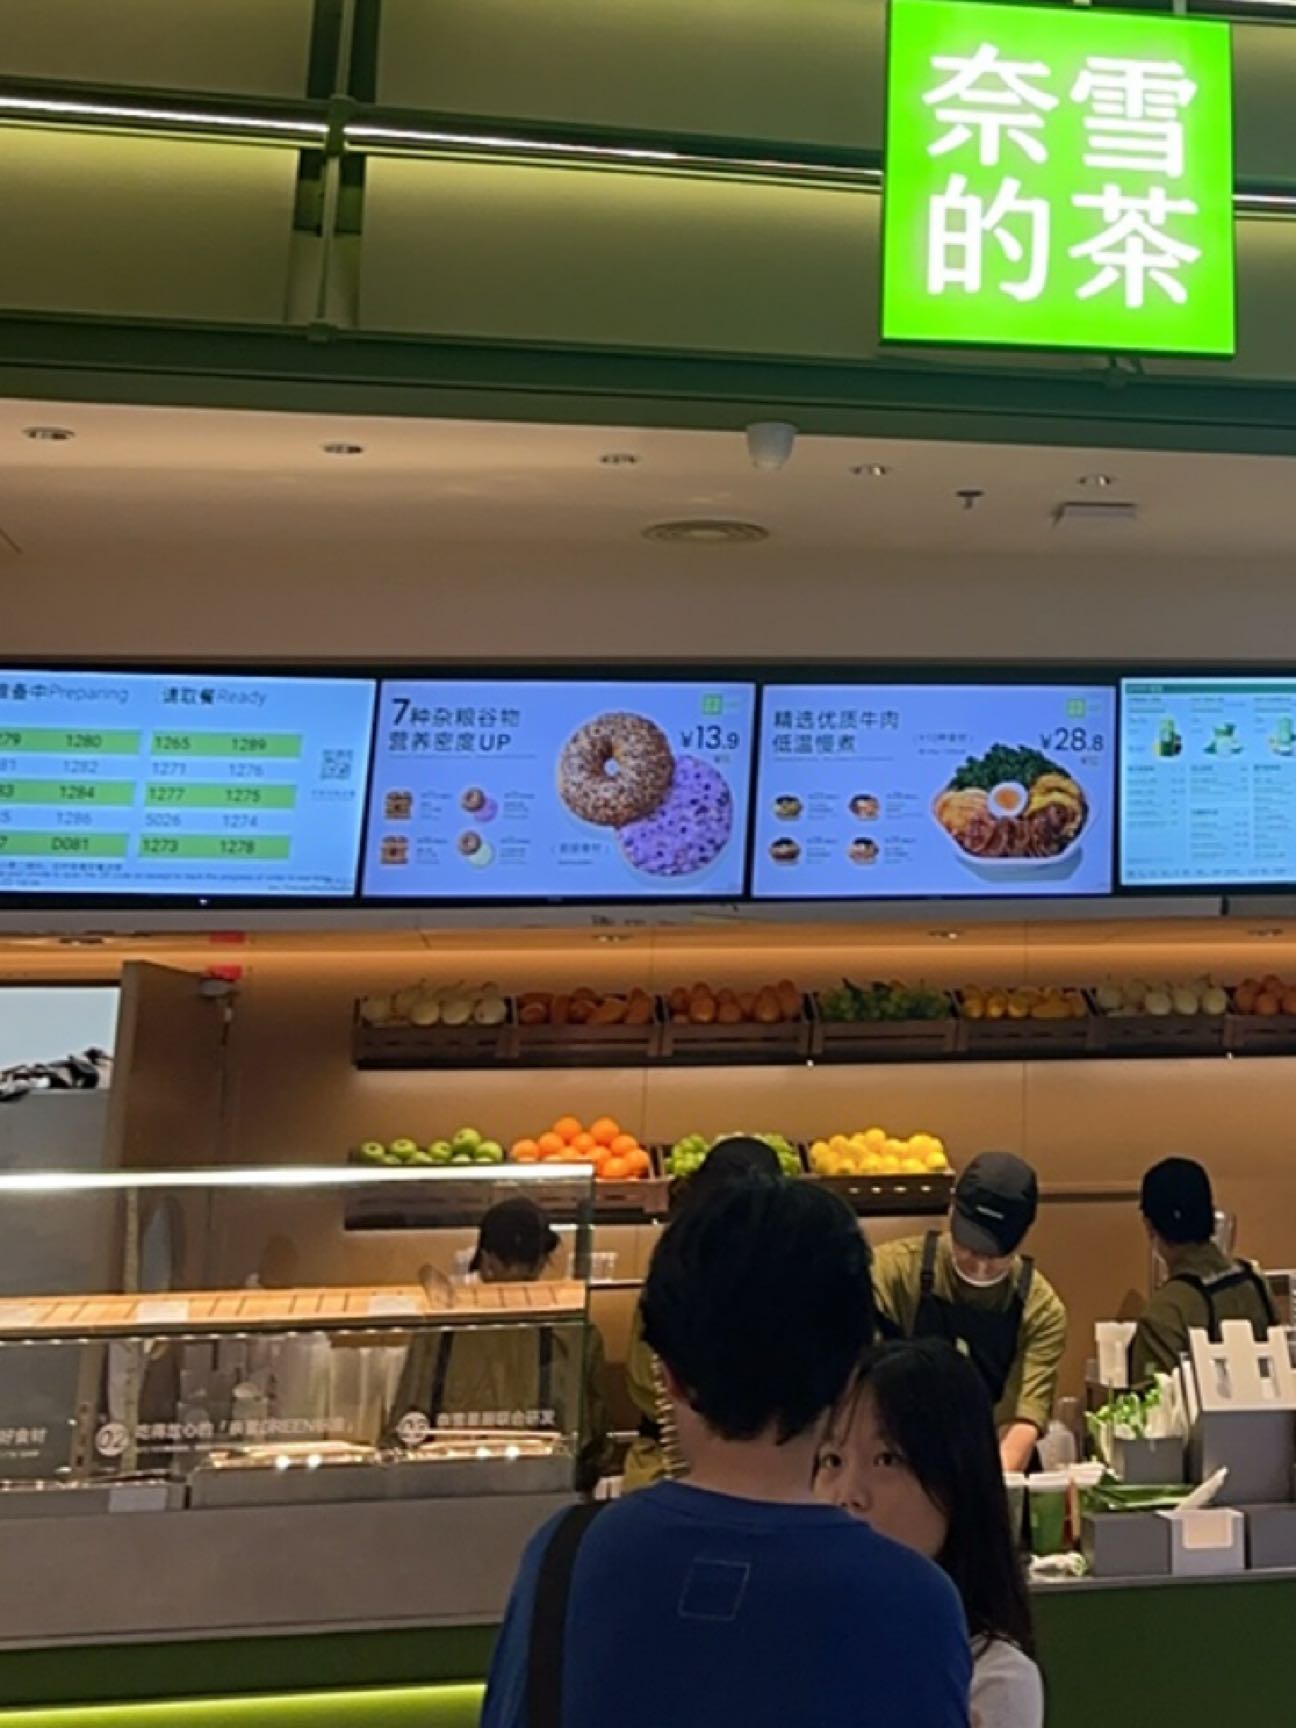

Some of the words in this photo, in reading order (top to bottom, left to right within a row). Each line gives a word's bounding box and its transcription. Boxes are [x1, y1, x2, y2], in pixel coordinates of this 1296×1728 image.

[922, 43, 1197, 178] 奈雪
[926, 173, 1202, 309] 的茶
[773, 709, 900, 730] 精选优质牛肉
